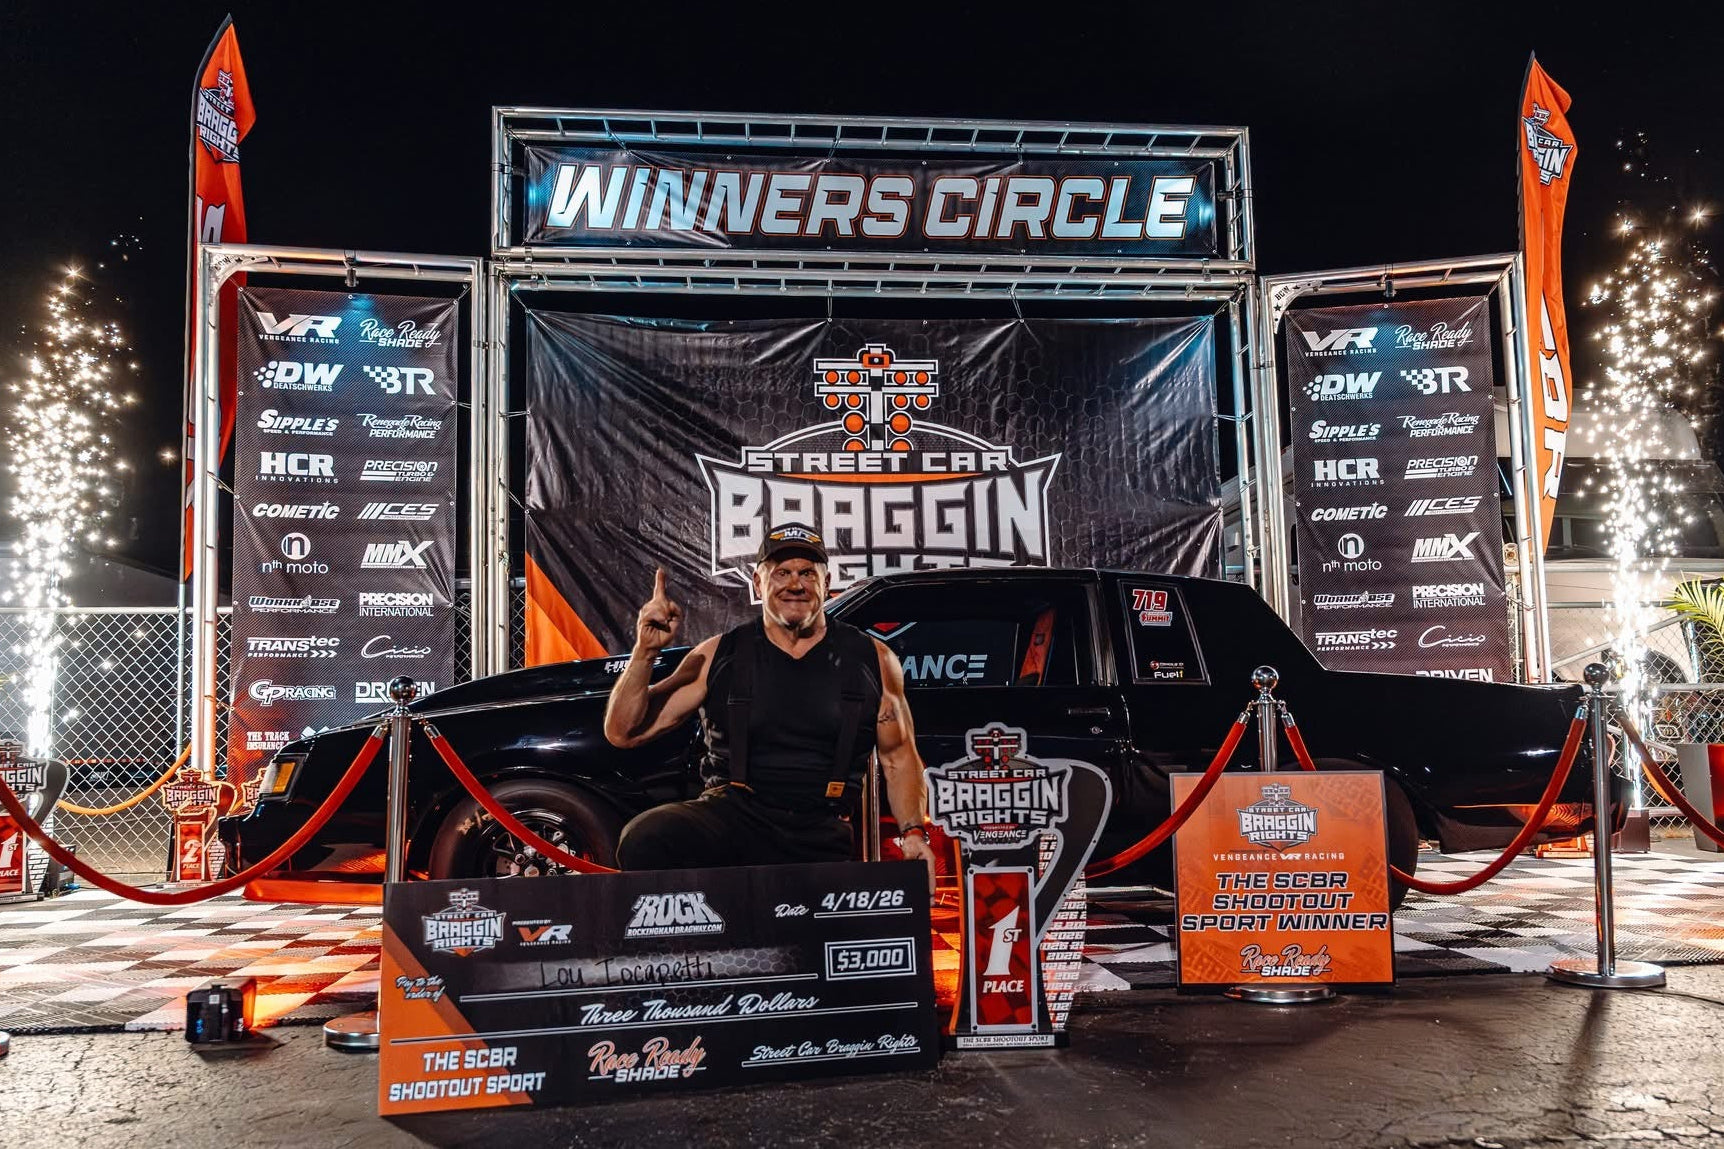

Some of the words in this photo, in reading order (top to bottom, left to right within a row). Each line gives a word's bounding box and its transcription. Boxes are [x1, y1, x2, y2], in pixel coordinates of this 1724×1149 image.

[197, 92, 239, 145] BRAGG
[545, 164, 911, 237] WINNERS
[923, 174, 1197, 241] CIRCLE
[256, 312, 342, 338] VR
[360, 318, 395, 339] Race
[397, 320, 441, 347] Ready
[1395, 325, 1427, 345] Race
[1431, 322, 1473, 346] Ready
[259, 334, 307, 342] VENGEANCE
[378, 338, 423, 348] SHADE
[1303, 327, 1378, 351] VR
[1413, 340, 1454, 350] SHADE
[274, 361, 344, 385] DW
[376, 365, 436, 395] BTR
[1412, 366, 1472, 395] BTR
[273, 383, 332, 392] DEATSCHWERKS
[1321, 372, 1382, 393] DW
[1320, 392, 1373, 401] DEATSCHWERKS
[357, 413, 409, 430] Renegade
[405, 414, 442, 430] Racing
[1397, 415, 1446, 428] Renegade
[1442, 412, 1479, 425] Racing
[369, 429, 436, 439] PERFORMANCE
[1410, 426, 1474, 438] PERFORMANCE
[260, 452, 334, 476] HCR
[364, 460, 438, 472] PRECISION
[748, 452, 907, 472] STREET
[922, 452, 1007, 471] CAR
[1313, 458, 1381, 481] HCR
[1407, 456, 1478, 469] PRECISION
[255, 475, 339, 484] INNOVATIONS
[1311, 480, 1385, 488] INNOVATIONS
[252, 501, 340, 519] COMETIC
[383, 503, 439, 515] CES
[1311, 502, 1388, 522] COMETIC
[1428, 496, 1482, 510] CES
[713, 468, 1046, 560] BRAGGIN
[363, 540, 435, 566] MMX
[1413, 532, 1480, 558] MMX
[286, 561, 329, 574] moto
[1344, 559, 1382, 571] moto
[359, 592, 434, 606] PRECISION
[1412, 583, 1485, 597] PRECISION
[1133, 589, 1168, 611] 719
[1316, 602, 1392, 610] PERFORMANCE
[1413, 597, 1486, 609] INTERNATIONAL
[359, 607, 434, 617] INTERNATIONAL
[902, 654, 988, 679] ANCE
[355, 681, 435, 698] DRIEN
[247, 731, 262, 741] THE
[264, 731, 290, 741] TRACK
[948, 770, 1009, 780] STREET
[1013, 769, 1046, 778] CAR
[166, 788, 216, 802] BRAGGIN
[935, 776, 1060, 814] BRAGGIN
[950, 809, 1049, 827] RIGHTS
[1240, 812, 1316, 832] BRAGGIN
[973, 829, 1027, 841] VENGEANCE
[1250, 831, 1308, 841] RIGHTS
[1213, 853, 1277, 861] VENGEANCE
[1304, 852, 1345, 860] RACING
[1216, 872, 1269, 890] THE
[1273, 872, 1348, 889] SCBR
[821, 889, 905, 910] 4/18/26
[1213, 892, 1354, 911] SHOOTOUT
[630, 893, 722, 927] ROCK
[774, 904, 810, 919] Date
[426, 917, 501, 940] BRAGGIN
[1181, 913, 1273, 932] SPORT
[1277, 913, 1389, 931] WINNER
[518, 924, 573, 942] VR
[1051, 931, 1085, 940] 2026
[434, 937, 495, 948] RIGHTS
[837, 949, 904, 971] $3,000
[1046, 952, 1082, 960] 2026
[1240, 944, 1279, 970] Race
[1281, 944, 1332, 975] Ready
[540, 961, 584, 988] Lou
[1260, 965, 1313, 977] SHADE
[396, 976, 415, 992] Pay
[415, 977, 426, 986] to
[426, 974, 444, 986] the
[983, 980, 1024, 993] PLACE
[405, 987, 433, 999] order
[432, 985, 446, 1002] of
[581, 1003, 639, 1027] Three
[643, 995, 732, 1021] Thousand
[737, 992, 820, 1014] Dollars
[588, 1040, 638, 1075] Race
[643, 1036, 706, 1077] Ready
[750, 1045, 794, 1062] Street
[797, 1041, 822, 1056] Car
[826, 1039, 873, 1058] Braggin
[877, 1034, 919, 1054] Rights
[423, 1051, 460, 1072] THE
[463, 1046, 518, 1068] SCBR
[615, 1065, 679, 1083] SHADE
[388, 1077, 484, 1102] SHOOTOUT
[486, 1071, 547, 1095] SPORT
